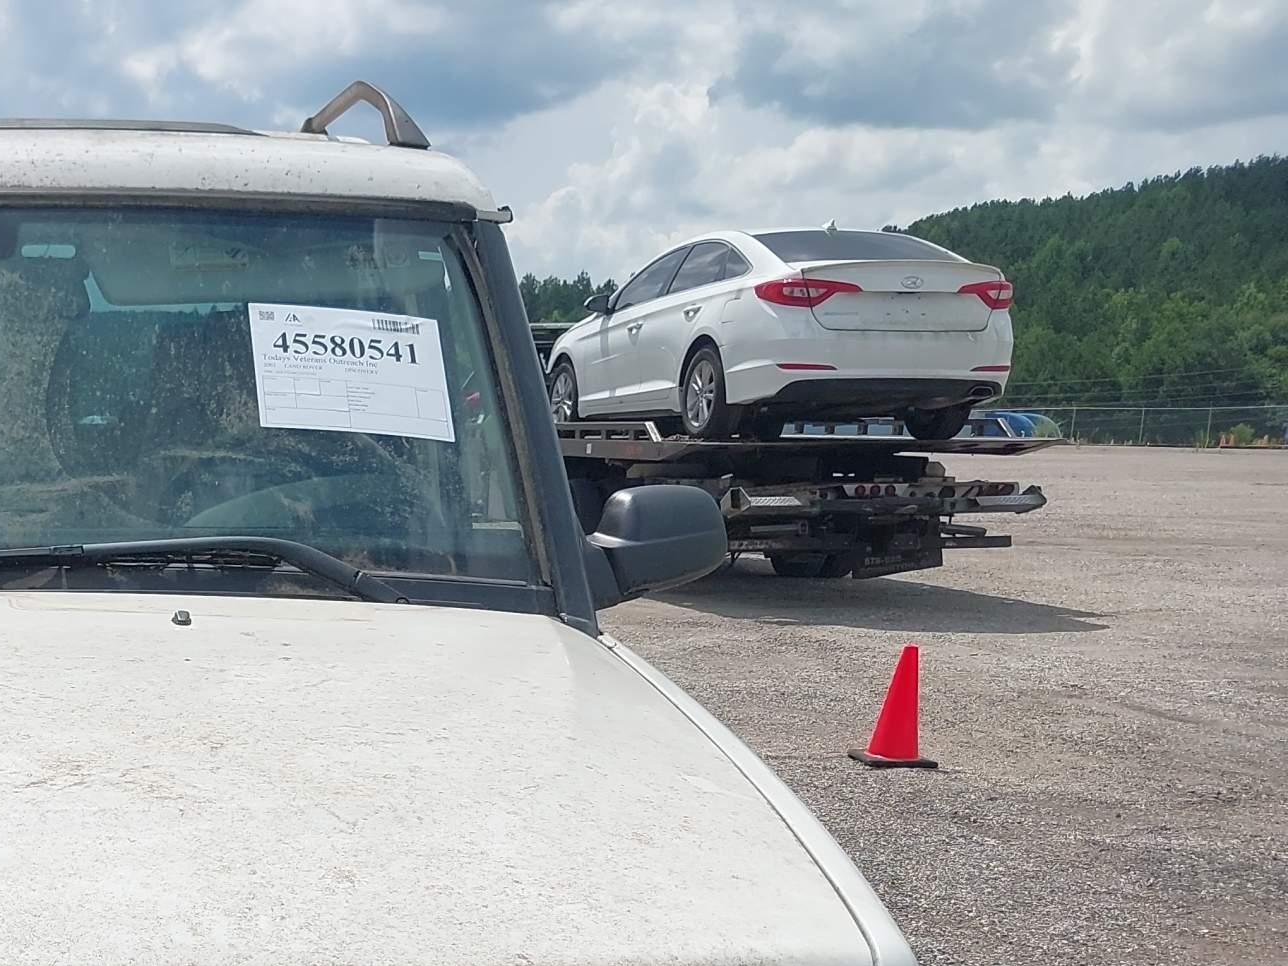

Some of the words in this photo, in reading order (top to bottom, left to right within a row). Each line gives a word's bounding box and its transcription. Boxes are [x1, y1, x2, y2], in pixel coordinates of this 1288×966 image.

[263, 353, 290, 363] Todays
[293, 355, 327, 364] Veterans
[329, 357, 365, 367] Outreach
[273, 331, 420, 365] 45580541
